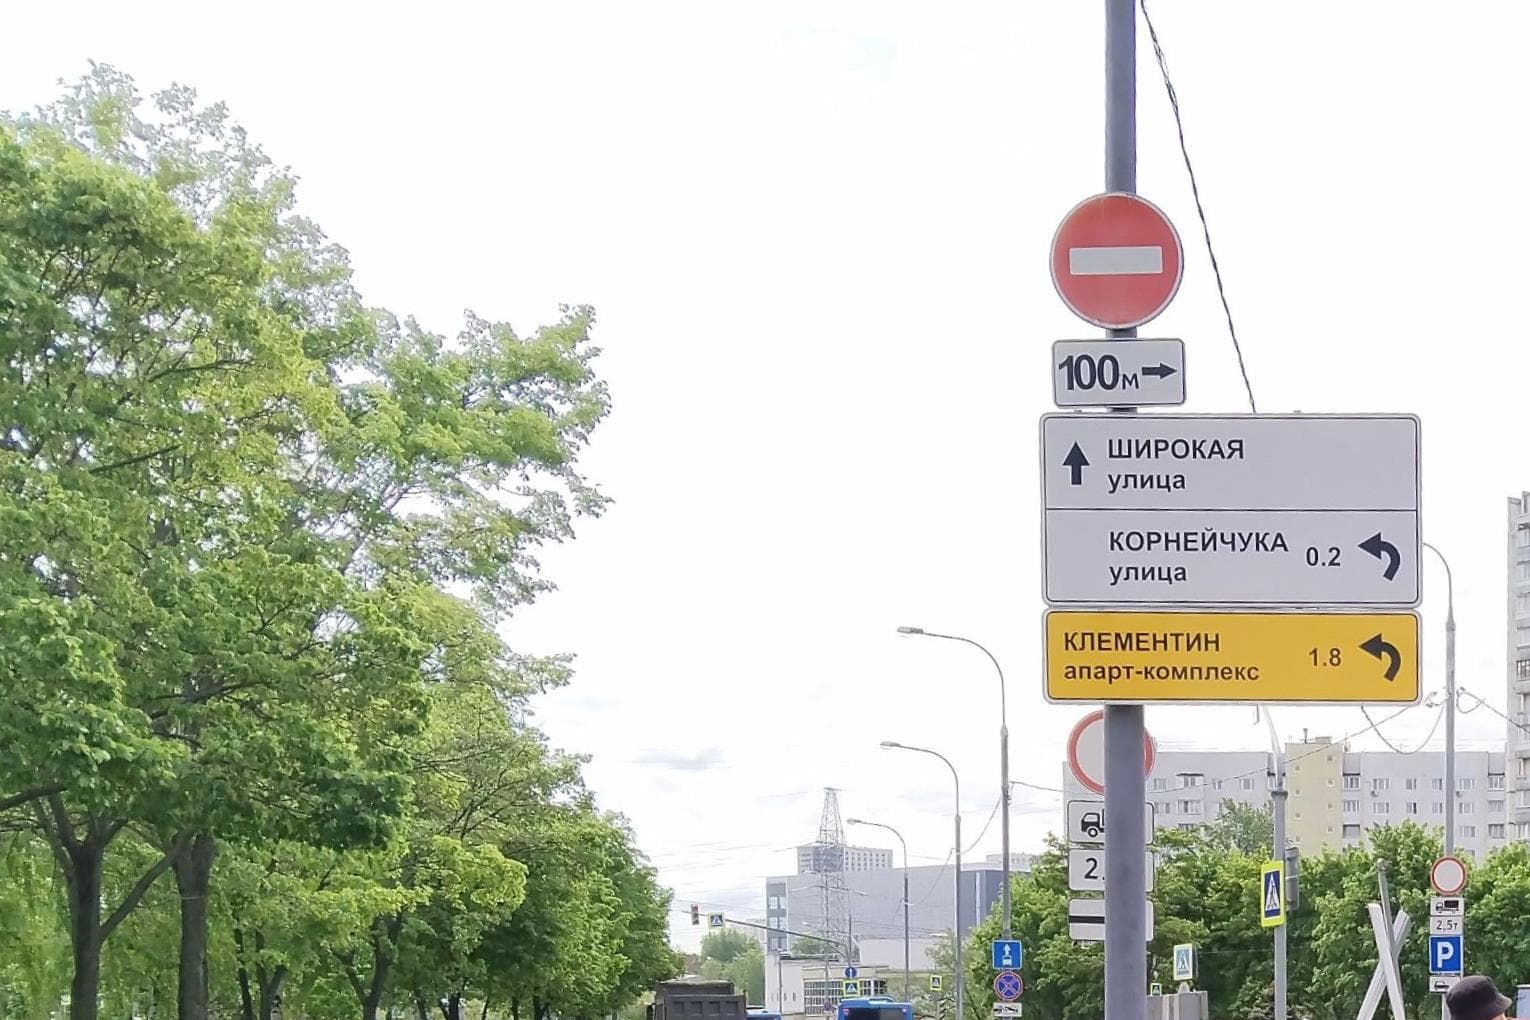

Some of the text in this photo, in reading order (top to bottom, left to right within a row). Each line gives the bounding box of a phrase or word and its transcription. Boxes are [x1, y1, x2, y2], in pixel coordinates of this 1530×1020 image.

[1108, 438, 1244, 461] ШИРОКАЯ
[1107, 472, 1186, 492] улица
[1109, 527, 1289, 554] КОРНЕЙЧУКА
[1305, 546, 1341, 568] 0.2
[1108, 563, 1187, 585] улица
[1064, 631, 1220, 652] КЛЕМЕНТИН
[1309, 647, 1341, 667] 1.8
[1064, 662, 1260, 684] апарт-комплекс
